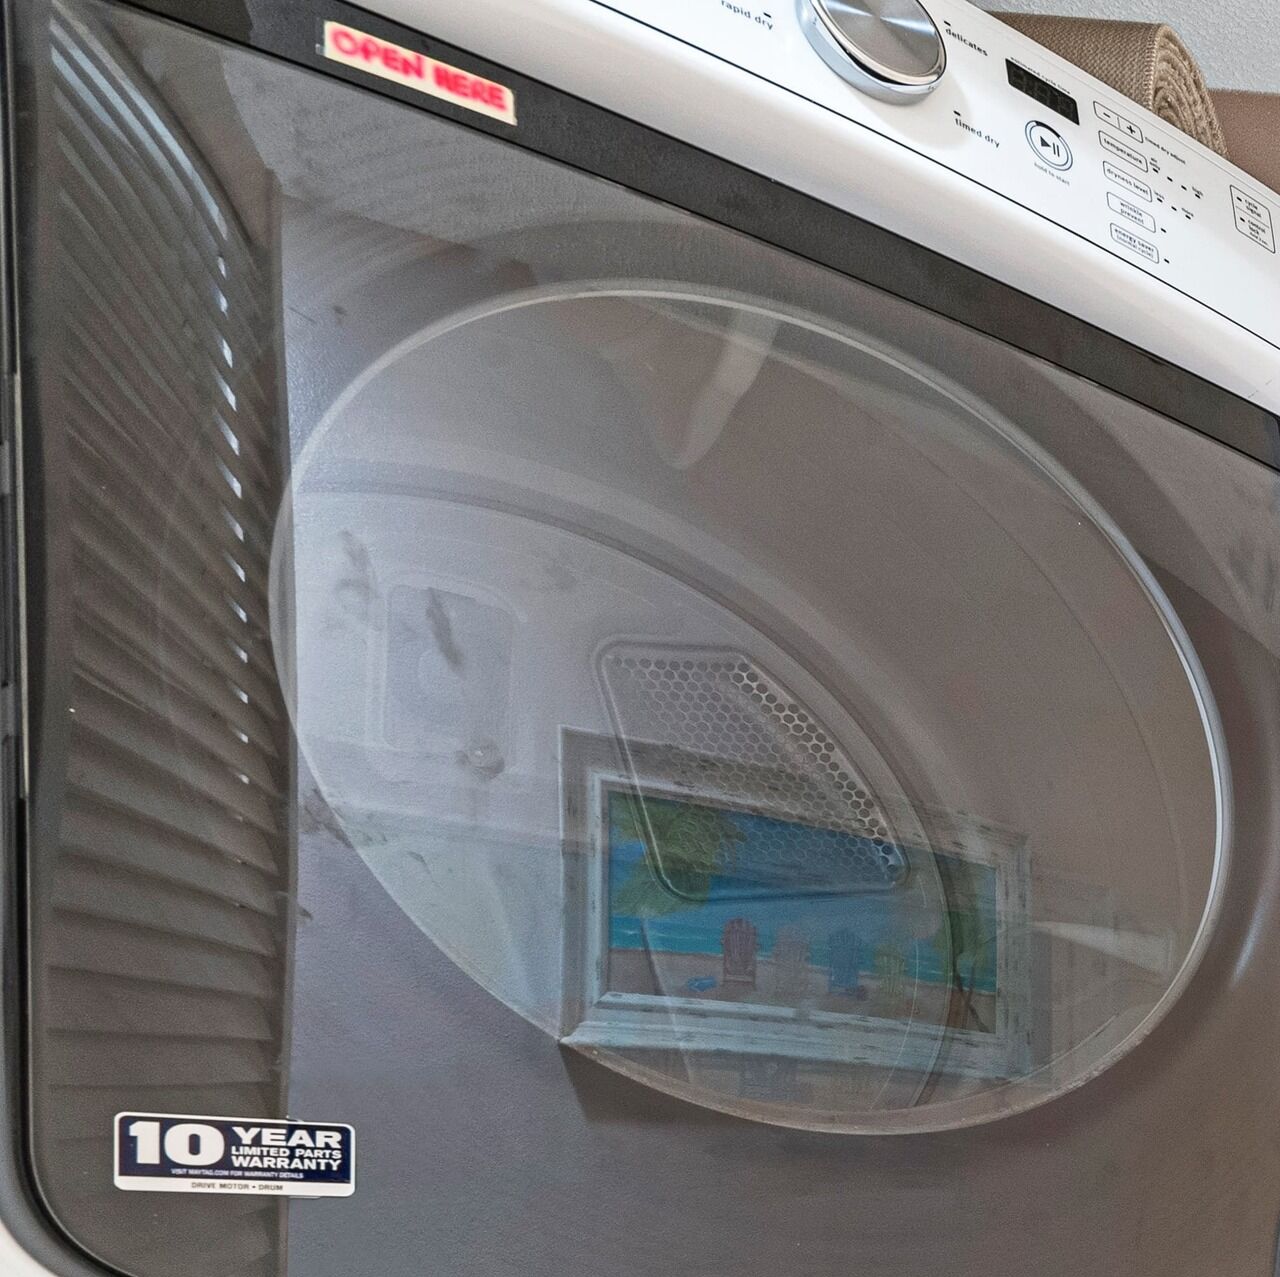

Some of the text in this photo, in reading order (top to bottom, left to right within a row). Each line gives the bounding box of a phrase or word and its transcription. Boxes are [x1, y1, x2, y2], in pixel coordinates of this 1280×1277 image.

[720, 0, 773, 30] rapid dry
[945, 28, 988, 57] delicates
[331, 29, 508, 112] OPEN HERE
[954, 117, 1000, 148] timed dry
[1103, 137, 1143, 165] temperature
[1106, 167, 1149, 196] dryness level
[1119, 200, 1143, 217] wrinkle
[1120, 208, 1144, 225] prevent
[1114, 228, 1155, 253] energy saver
[129, 1120, 342, 1167] 10 YEAR
[231, 1145, 342, 1160] LIMITED PARTS
[231, 1155, 342, 1172] WARRANTY
[191, 1181, 284, 1191] DRIVE MOTOR DRUM
